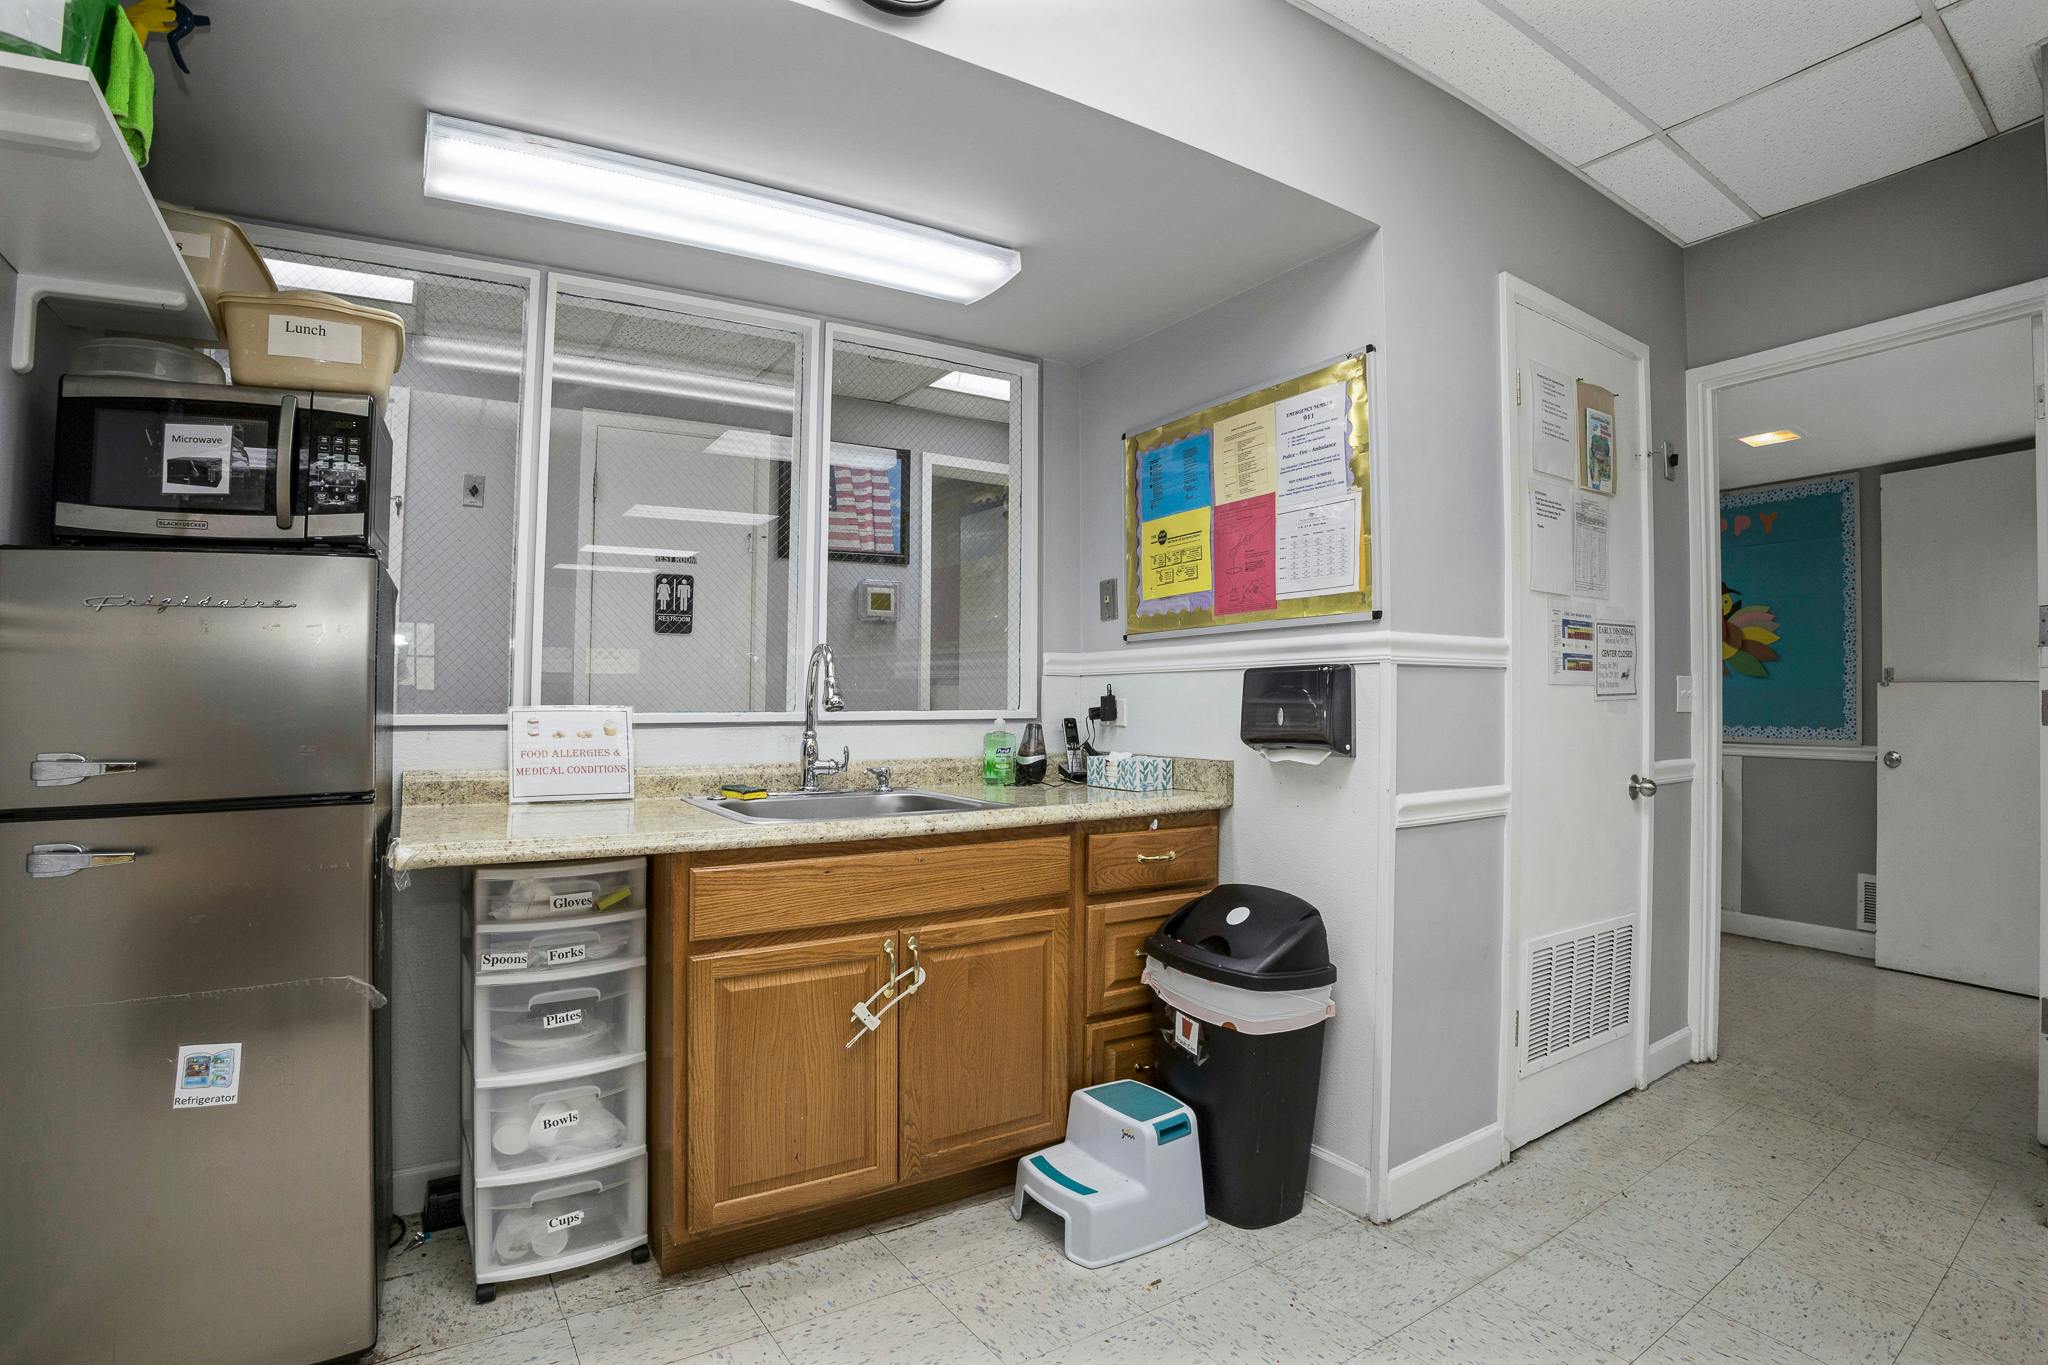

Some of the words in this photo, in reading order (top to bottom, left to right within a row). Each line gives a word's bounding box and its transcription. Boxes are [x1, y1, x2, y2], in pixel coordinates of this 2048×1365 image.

[285, 320, 326, 336] Lunch
[1303, 413, 1314, 421] 911
[172, 435, 222, 444] Microwave
[82, 594, 297, 614] Frigidaire
[1601, 650, 1617, 658] CENTER
[1618, 650, 1632, 658] CLOSED
[520, 750, 548, 759] FOOD
[551, 749, 611, 758] ALLERGIES
[613, 748, 621, 757] &
[516, 766, 564, 776] MEDICAL
[566, 765, 627, 775] CONDITIONS
[553, 896, 593, 909] Gloves
[482, 954, 527, 967] Spoons
[549, 947, 584, 961] Forks
[546, 1011, 582, 1026] Plates
[174, 1094, 236, 1106] Refrigerator
[543, 1112, 579, 1130] Bowls
[548, 1213, 580, 1229] Cups
